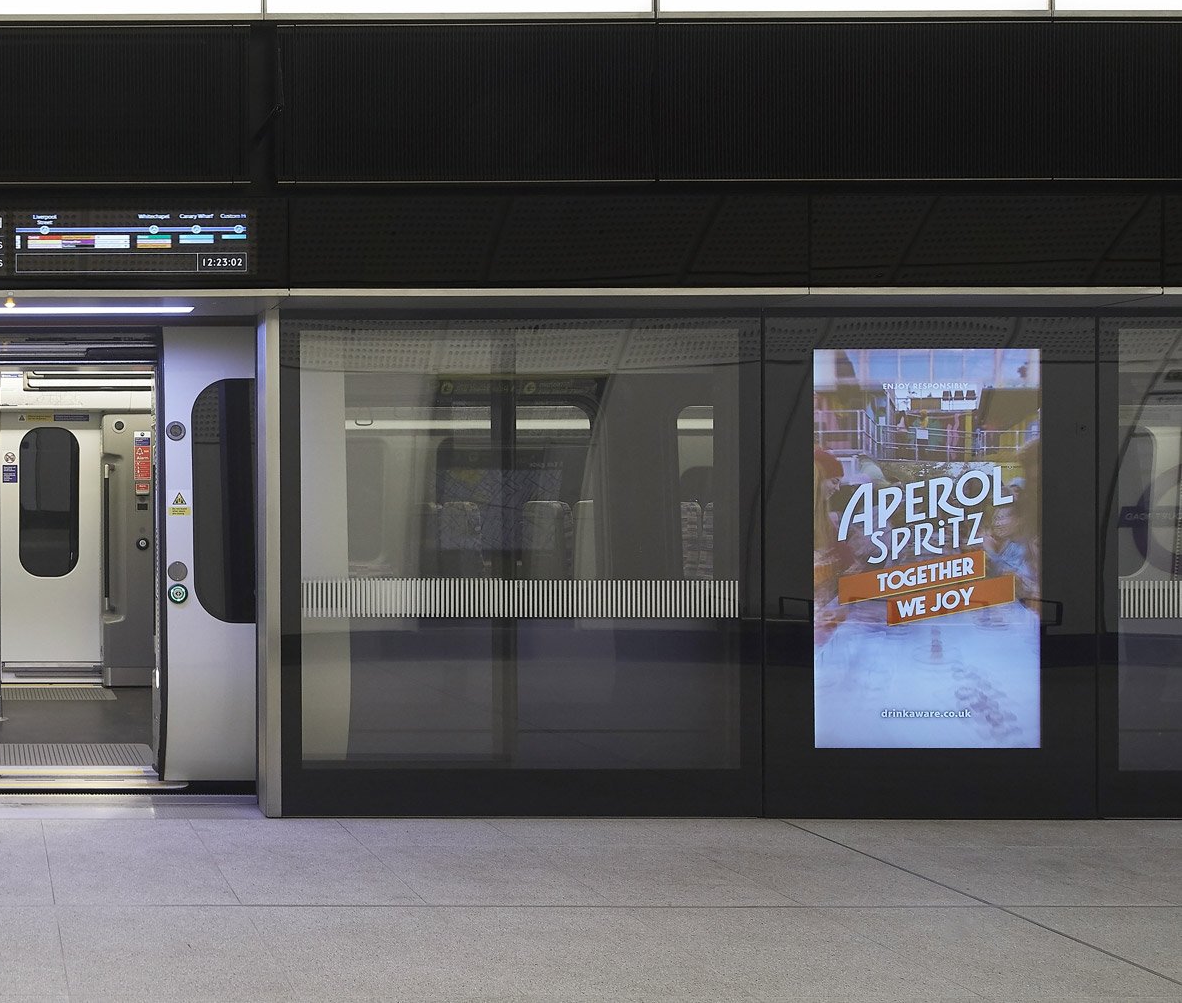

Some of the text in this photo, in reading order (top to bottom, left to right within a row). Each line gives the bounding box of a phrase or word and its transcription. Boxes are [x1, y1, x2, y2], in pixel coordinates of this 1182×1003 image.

[202, 258, 243, 267] 12:23:02
[882, 382, 969, 390] ENJOY RESPONSIBLY
[837, 466, 1014, 542] APEROL
[877, 557, 974, 591] TOGETHER
[897, 586, 975, 618] WE JOY
[881, 709, 971, 718] drinkaware.co.uk
